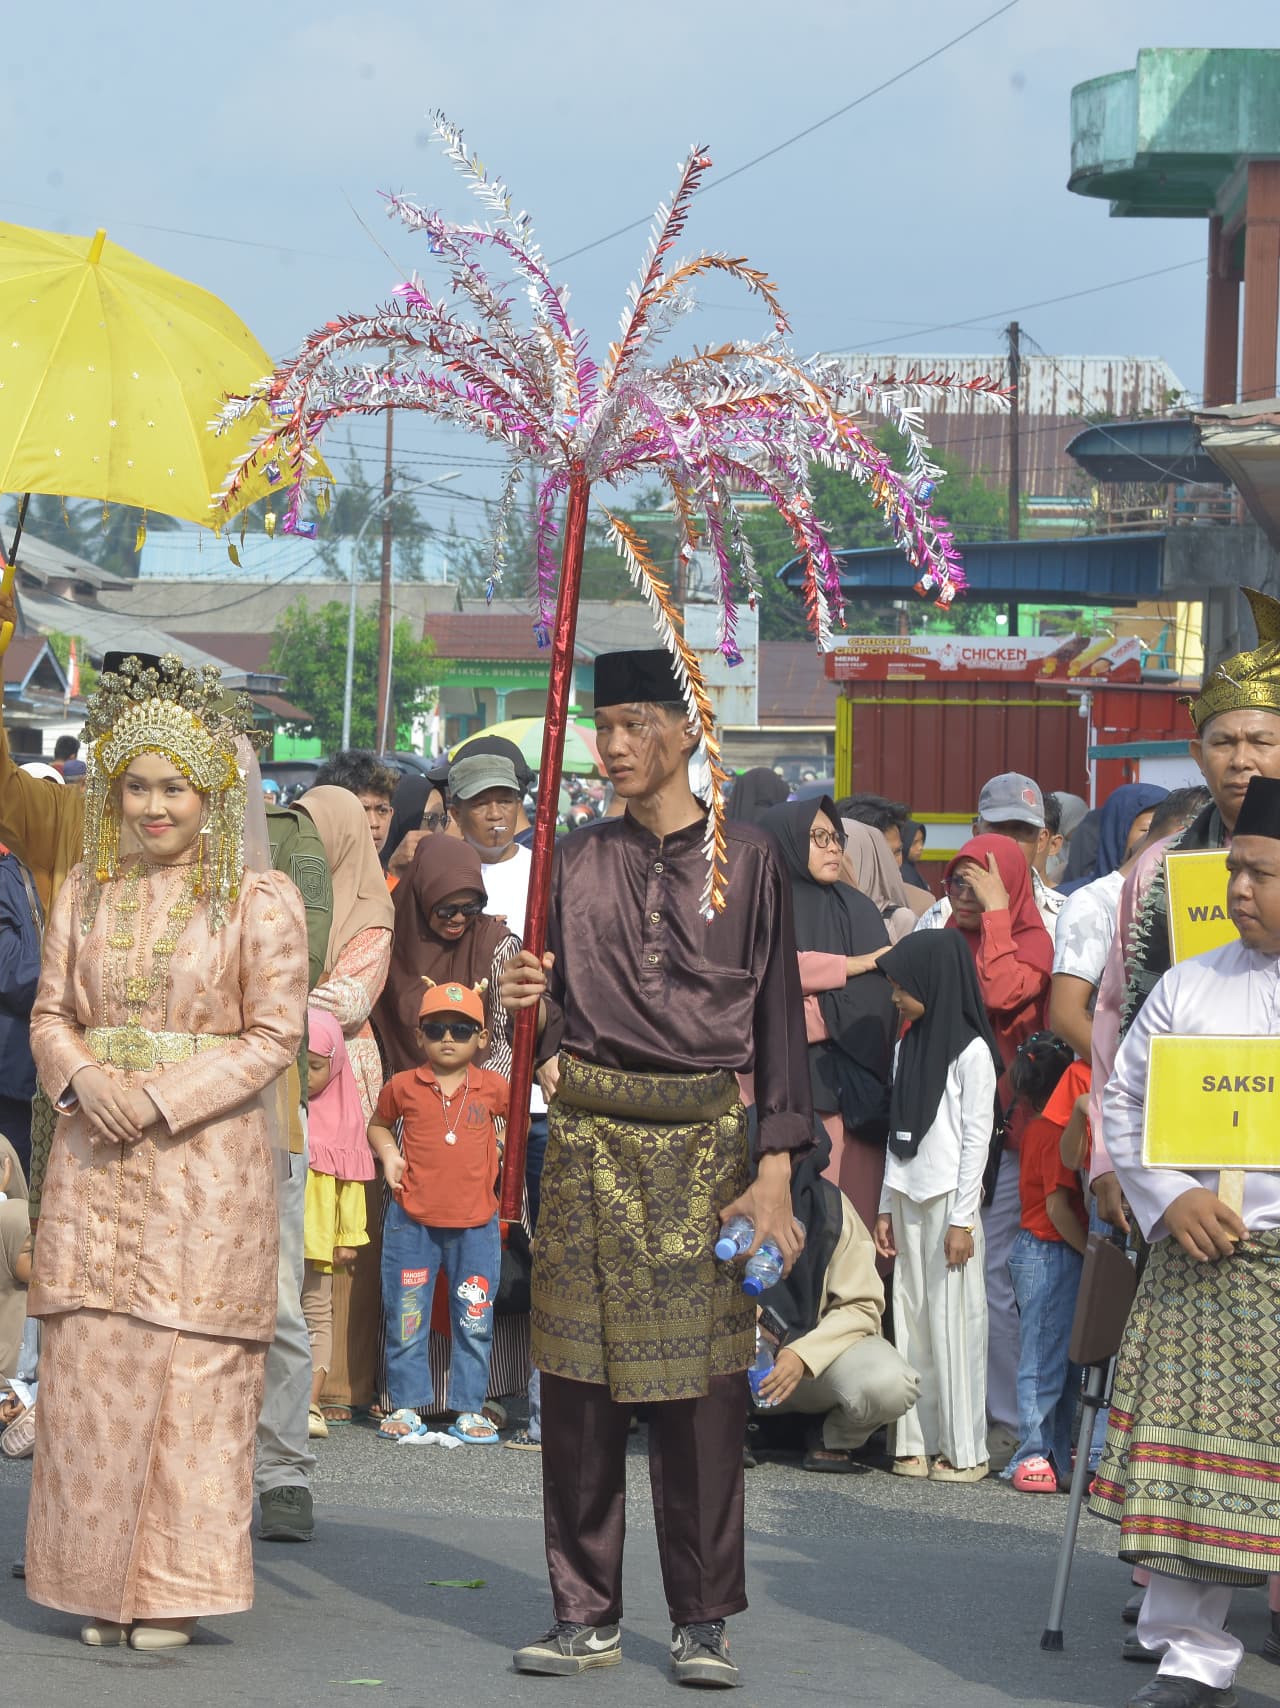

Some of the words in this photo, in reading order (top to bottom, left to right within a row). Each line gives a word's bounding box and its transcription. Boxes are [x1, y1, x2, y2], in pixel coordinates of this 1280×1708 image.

[961, 647, 1028, 661] CHICKEN
[1201, 1075, 1274, 1093] SAKSI
[1231, 1110, 1239, 1128] I
